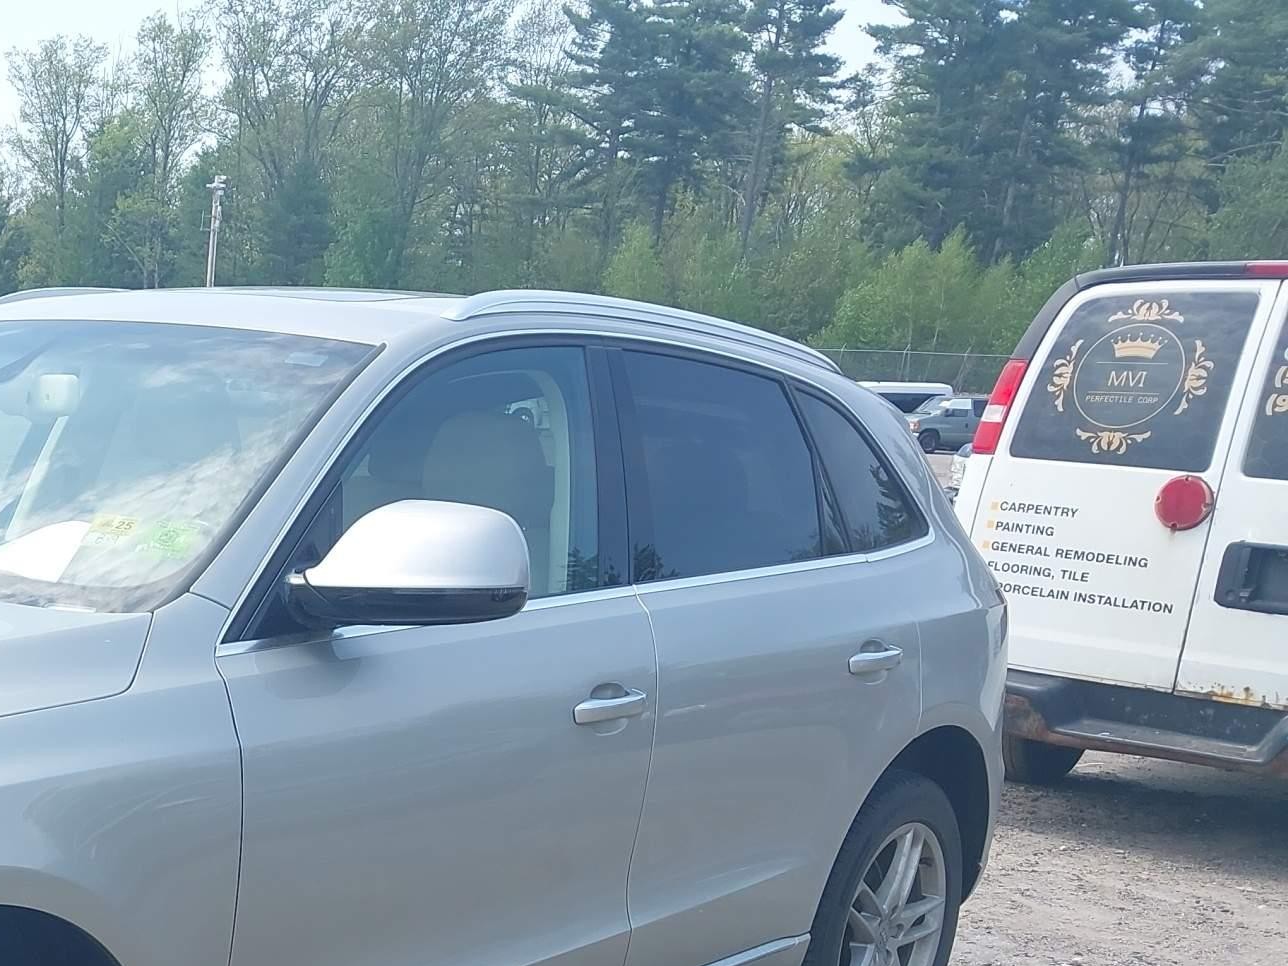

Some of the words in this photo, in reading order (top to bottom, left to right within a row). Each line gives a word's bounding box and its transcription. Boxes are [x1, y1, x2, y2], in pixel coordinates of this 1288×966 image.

[1107, 370, 1148, 387] MVI
[1085, 394, 1135, 404] PERFECTILE
[1137, 396, 1159, 404] CORP
[999, 500, 1079, 519] CARPENTRY
[114, 520, 135, 531] 25
[995, 520, 1055, 537] PAINTING
[991, 540, 1051, 558] GENERAL
[1054, 547, 1149, 569] REMODELING
[1060, 569, 1090, 583] TILE
[1073, 591, 1174, 614] INSTALLATION
